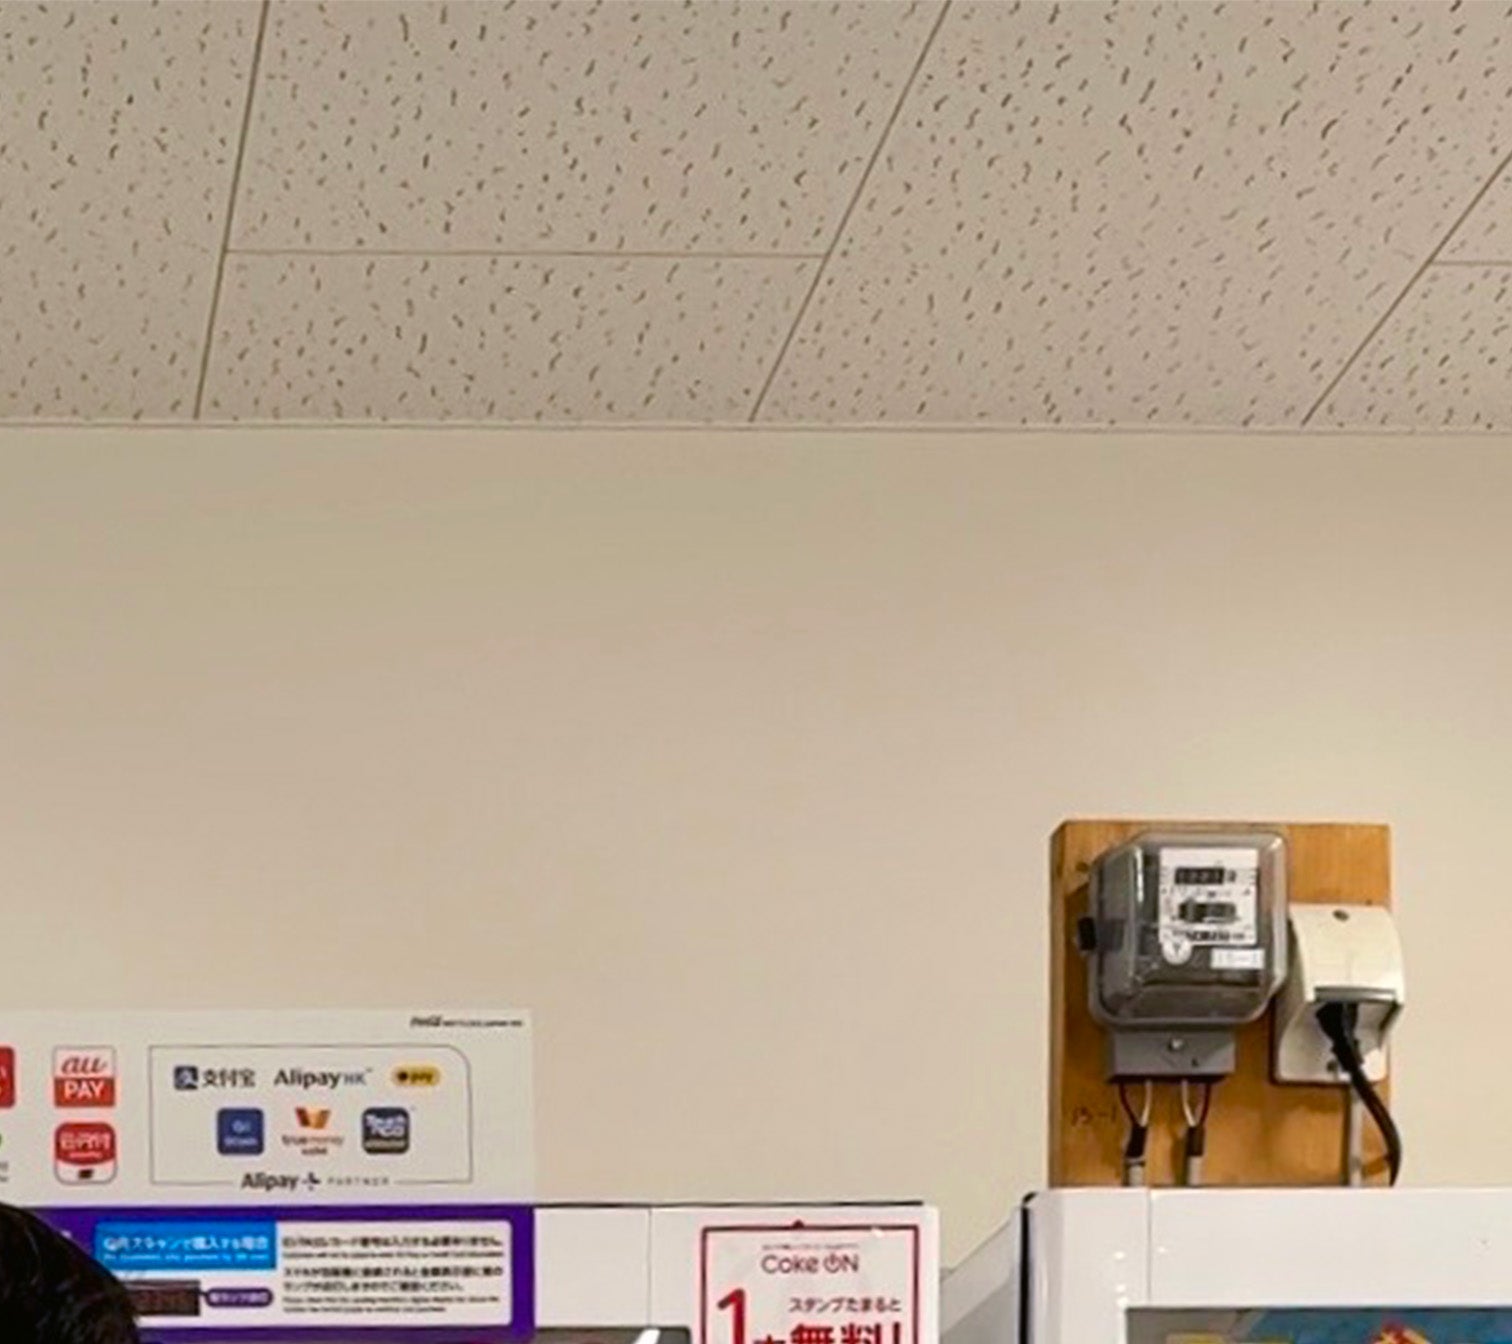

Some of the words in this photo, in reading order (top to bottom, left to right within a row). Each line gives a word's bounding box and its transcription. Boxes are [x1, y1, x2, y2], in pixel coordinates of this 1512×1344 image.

[62, 1056, 107, 1074] au
[63, 1081, 104, 1099] PAY
[761, 1253, 819, 1274] Coke
[789, 1298, 902, 1314] スタンプたまると
